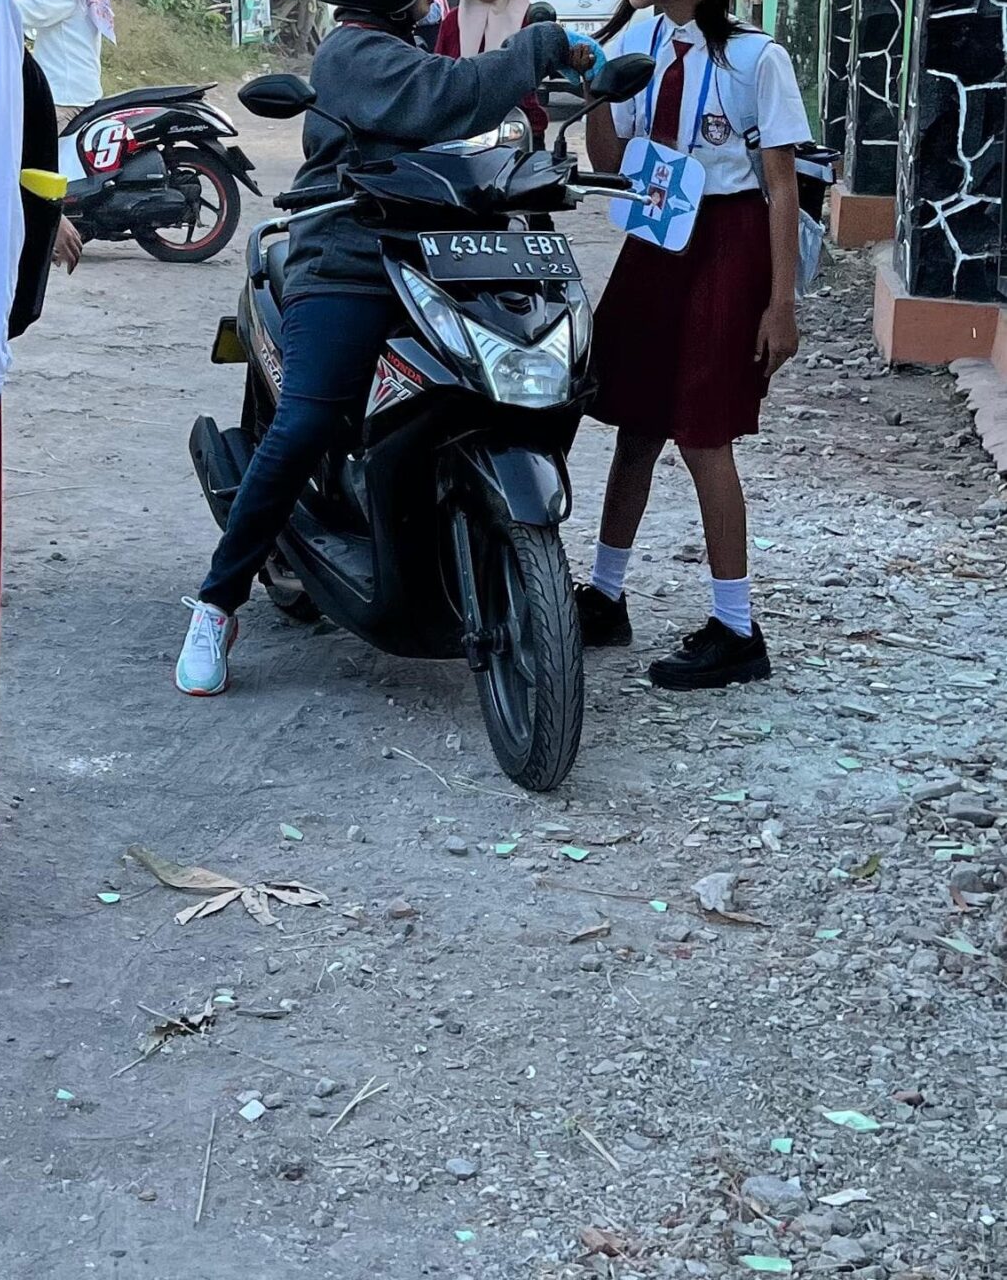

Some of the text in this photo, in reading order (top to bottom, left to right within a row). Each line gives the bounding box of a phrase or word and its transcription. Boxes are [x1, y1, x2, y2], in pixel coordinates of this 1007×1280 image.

[422, 236, 566, 256] N 4344 EBT
[387, 351, 423, 385] HONDA
